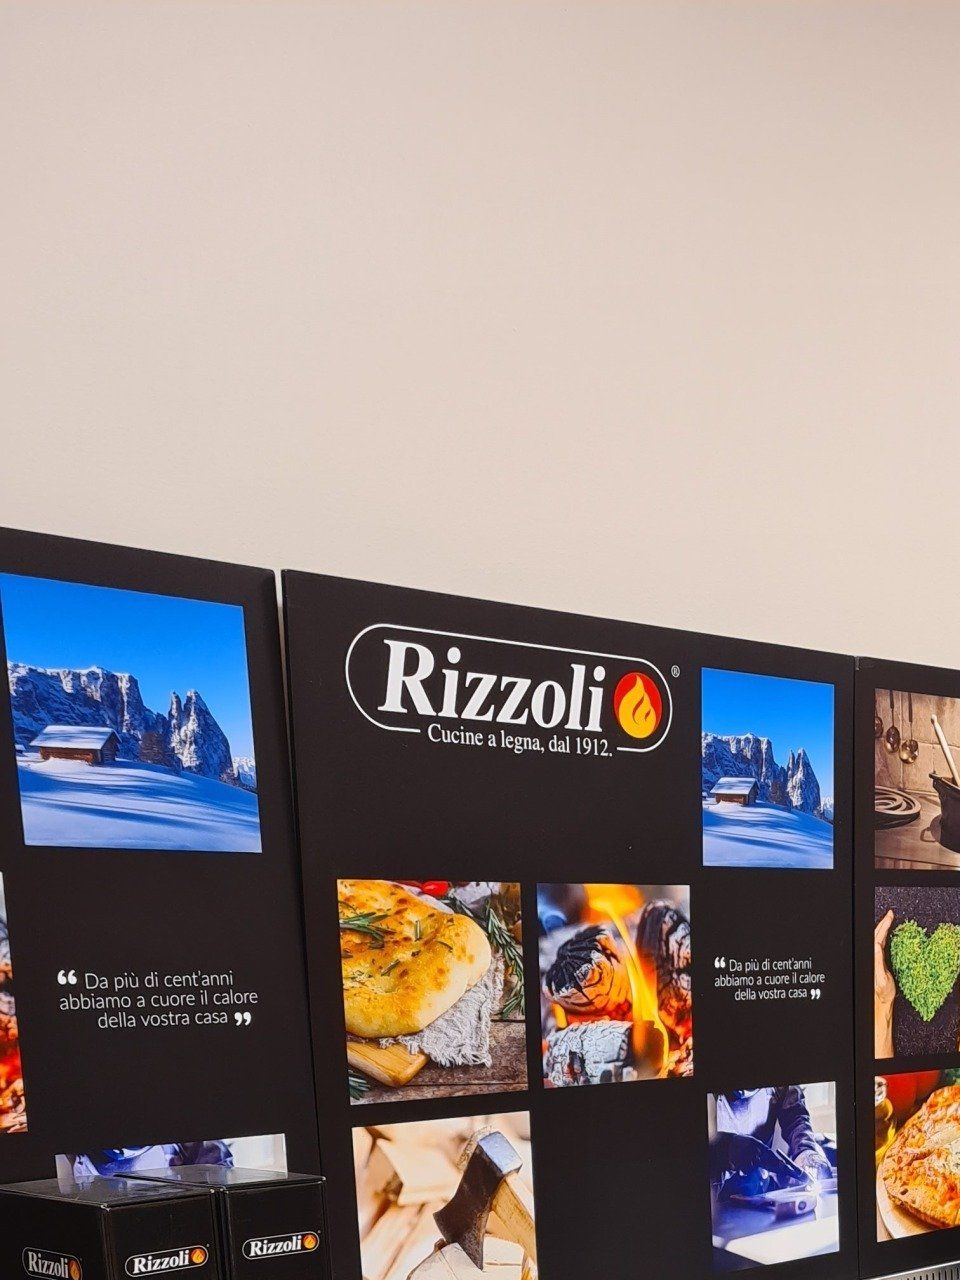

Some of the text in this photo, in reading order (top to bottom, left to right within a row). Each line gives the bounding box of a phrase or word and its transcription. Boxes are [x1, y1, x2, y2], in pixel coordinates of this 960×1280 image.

[378, 639, 606, 733] Rizzoli
[427, 723, 614, 758] Cucine a legna, dal 1912.
[729, 957, 812, 974] Da più di cent'anni
[85, 970, 234, 992] Da più di cent'anni
[714, 971, 826, 987] abbiamo a cuore il calore
[59, 988, 258, 1011] abbiamo a cuore il calore
[734, 987, 807, 1001] della vostra casa
[97, 1010, 228, 1029] della vostra casa
[249, 1235, 302, 1257] Rizzoli
[28, 1251, 70, 1280] Rizzoli
[132, 1249, 190, 1274] Rizzoli
